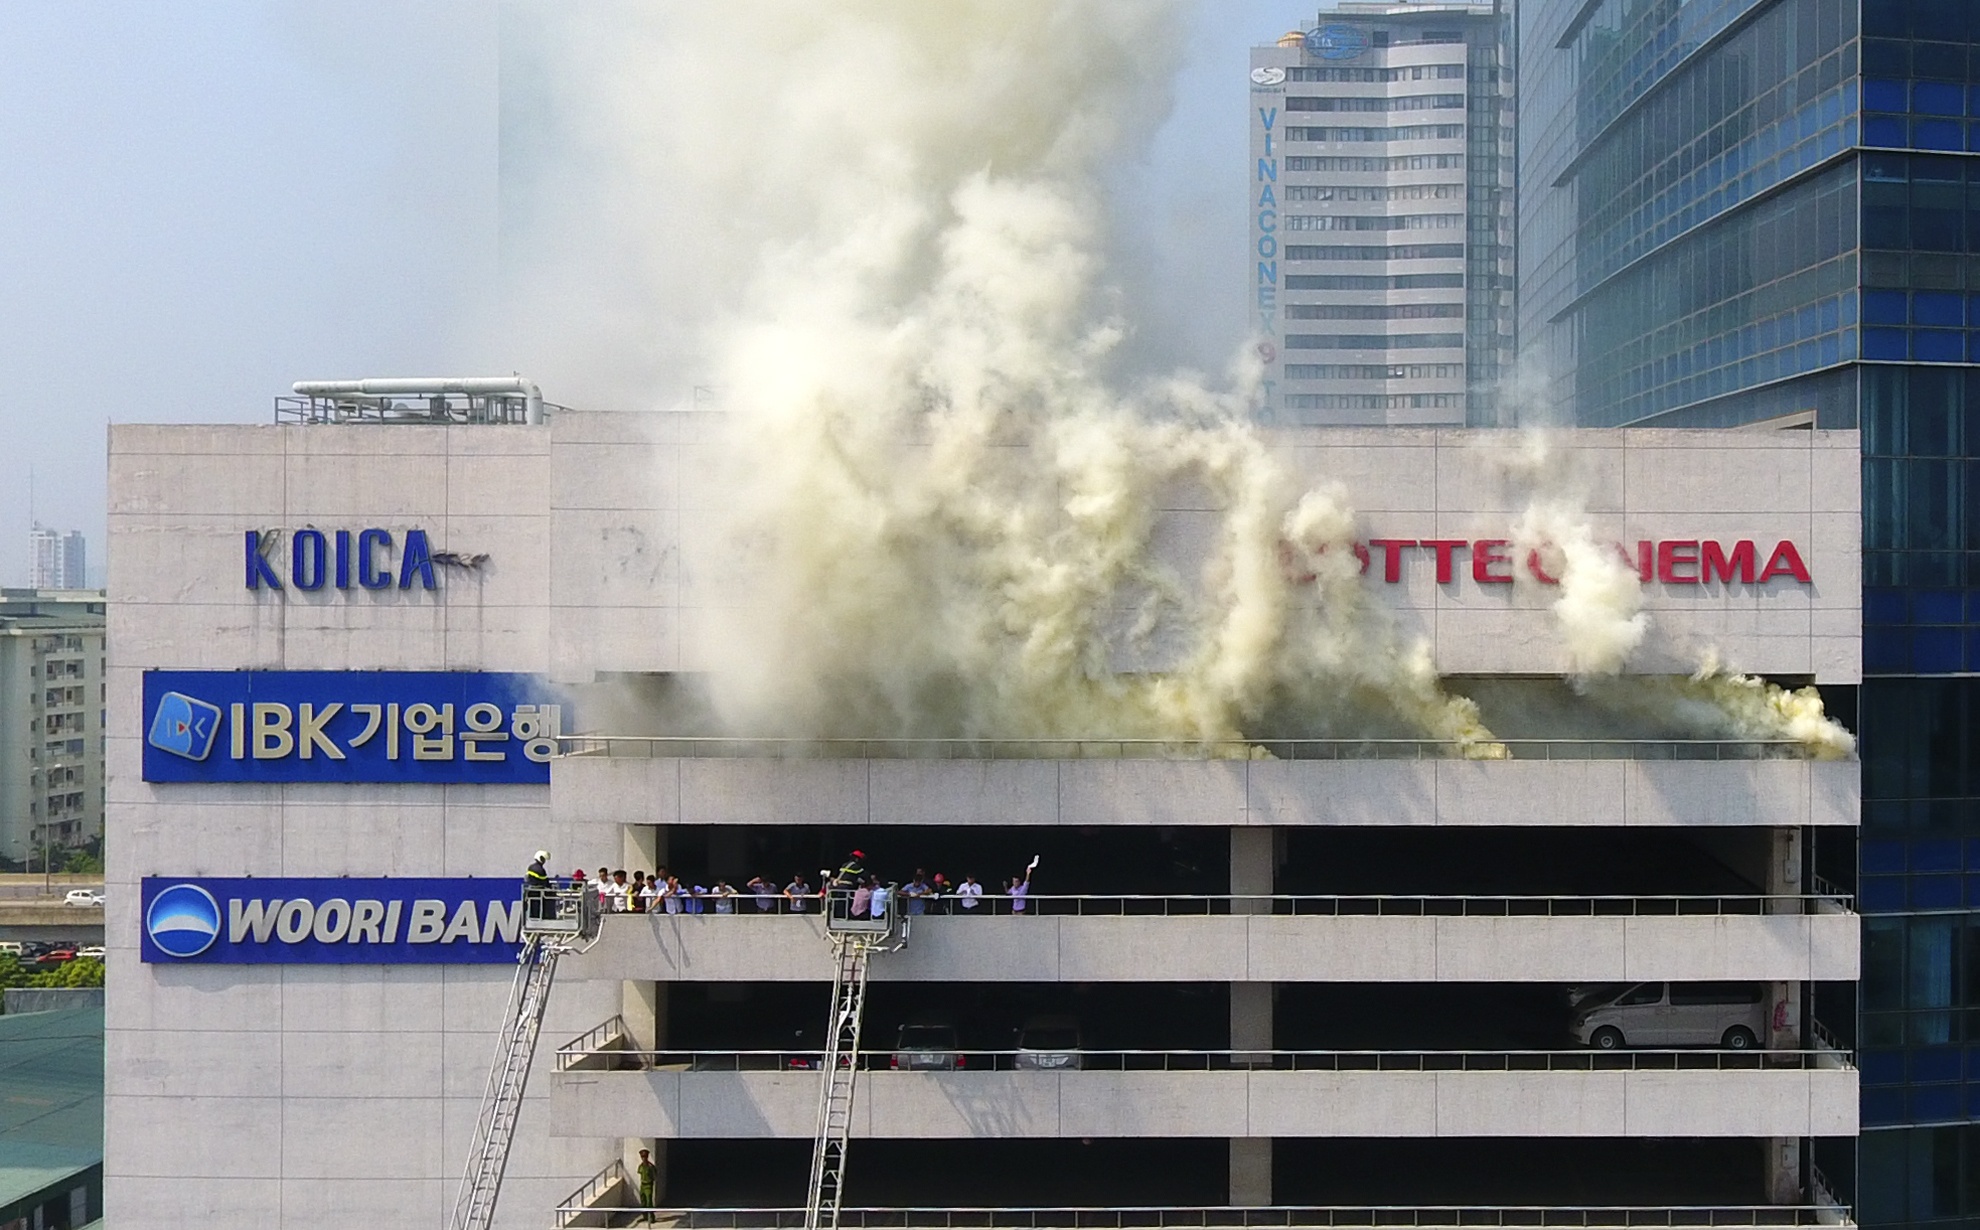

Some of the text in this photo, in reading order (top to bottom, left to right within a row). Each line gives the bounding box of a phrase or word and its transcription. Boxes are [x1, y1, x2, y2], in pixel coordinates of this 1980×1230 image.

[1257, 107, 1277, 336] VINACONEX
[245, 528, 437, 590] KOICA
[1527, 539, 1812, 584] CNEMA
[228, 898, 524, 944] WOORI BAN
